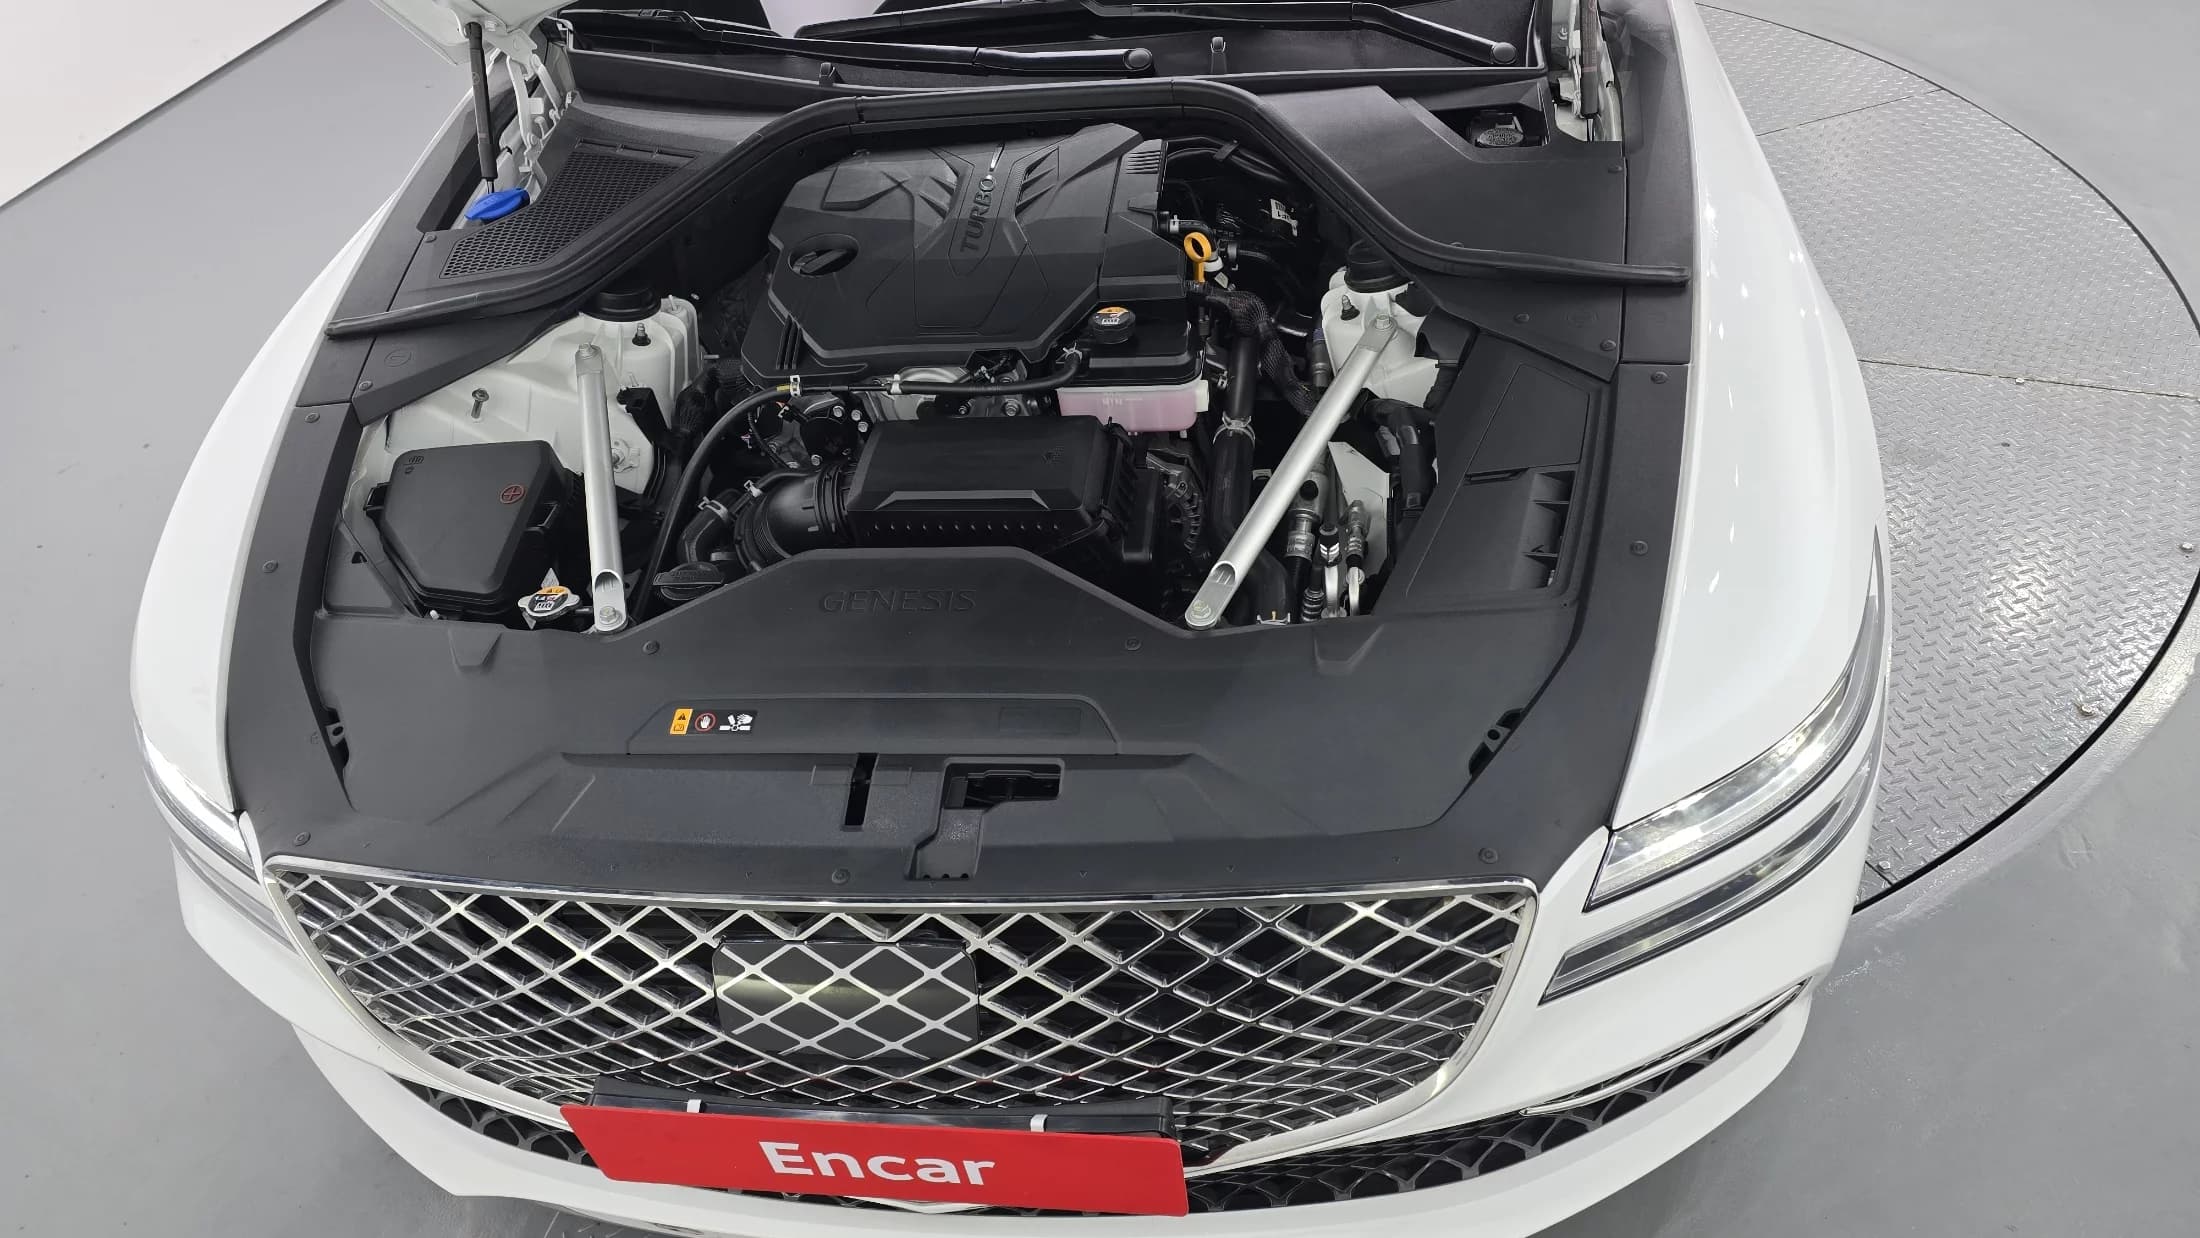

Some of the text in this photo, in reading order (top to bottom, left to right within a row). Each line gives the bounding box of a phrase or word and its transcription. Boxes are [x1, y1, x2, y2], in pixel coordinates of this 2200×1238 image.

[960, 177, 996, 252] TURBO
[820, 588, 977, 612] GENESIS
[759, 1141, 996, 1185] Encar
